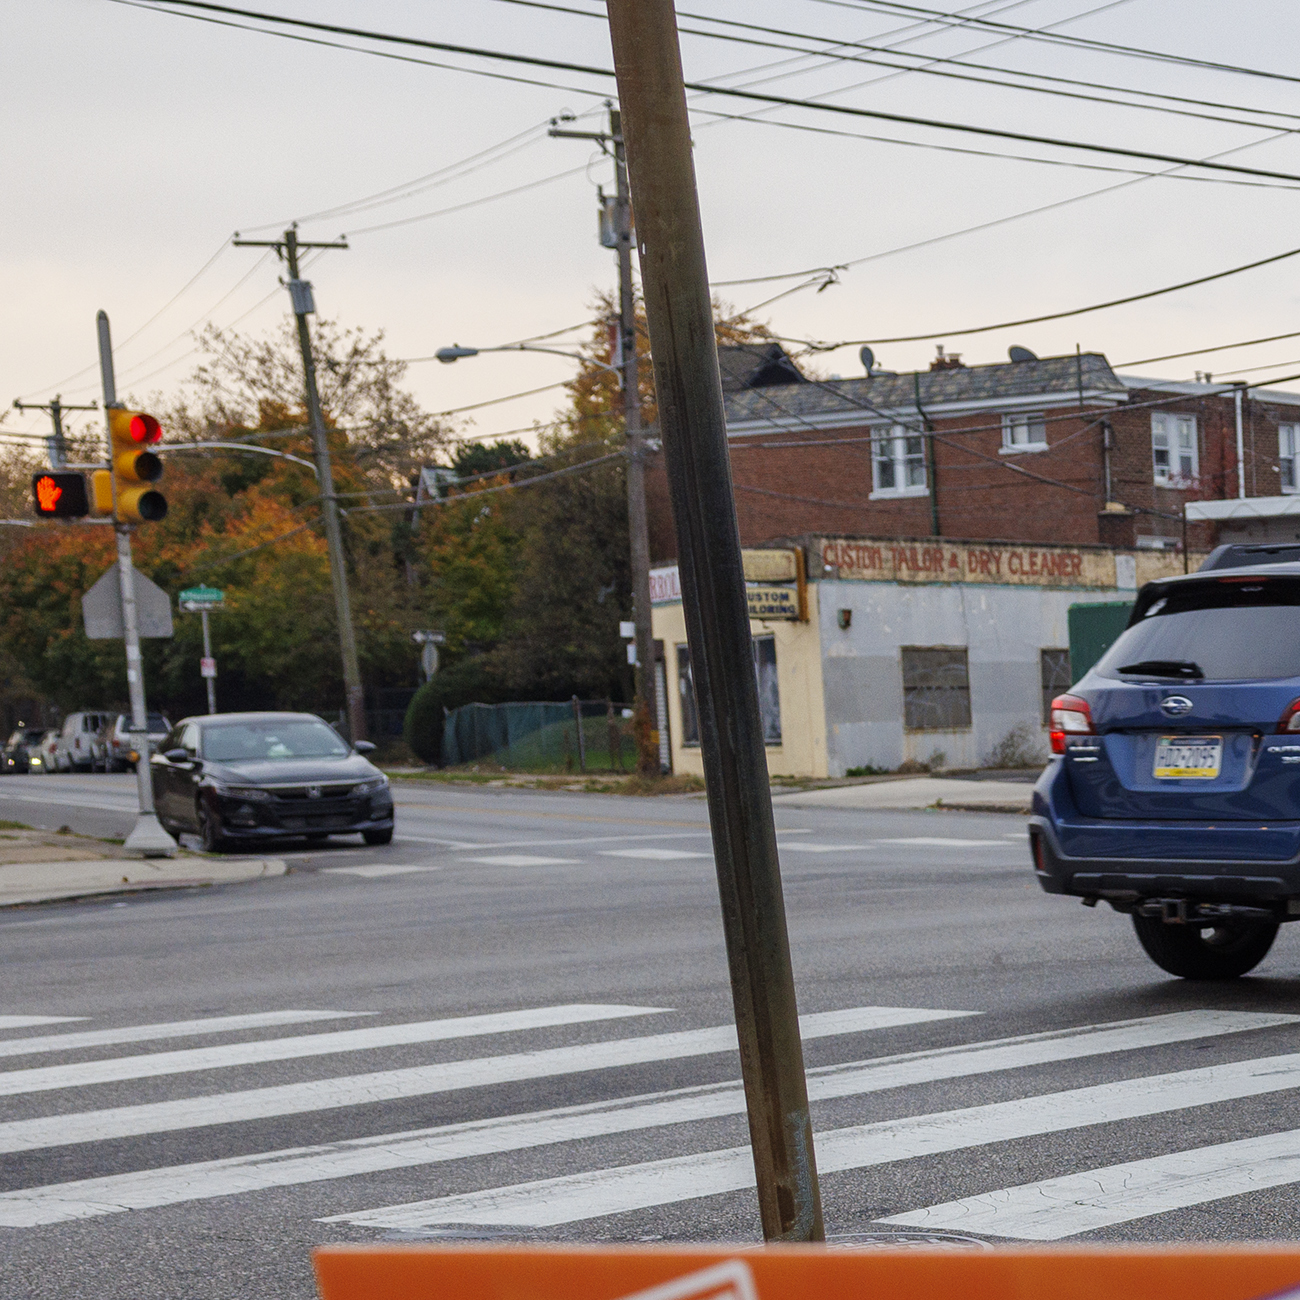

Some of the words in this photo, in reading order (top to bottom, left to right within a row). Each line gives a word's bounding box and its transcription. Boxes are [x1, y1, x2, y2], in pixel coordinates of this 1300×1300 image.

[823, 544, 882, 569] CUSTOM
[891, 547, 944, 572] TAILOR
[949, 554, 959, 568] &
[967, 550, 1003, 574] DRY
[1008, 551, 1082, 576] CLEANER
[749, 591, 789, 601] USTOM
[750, 605, 795, 614] ILORING
